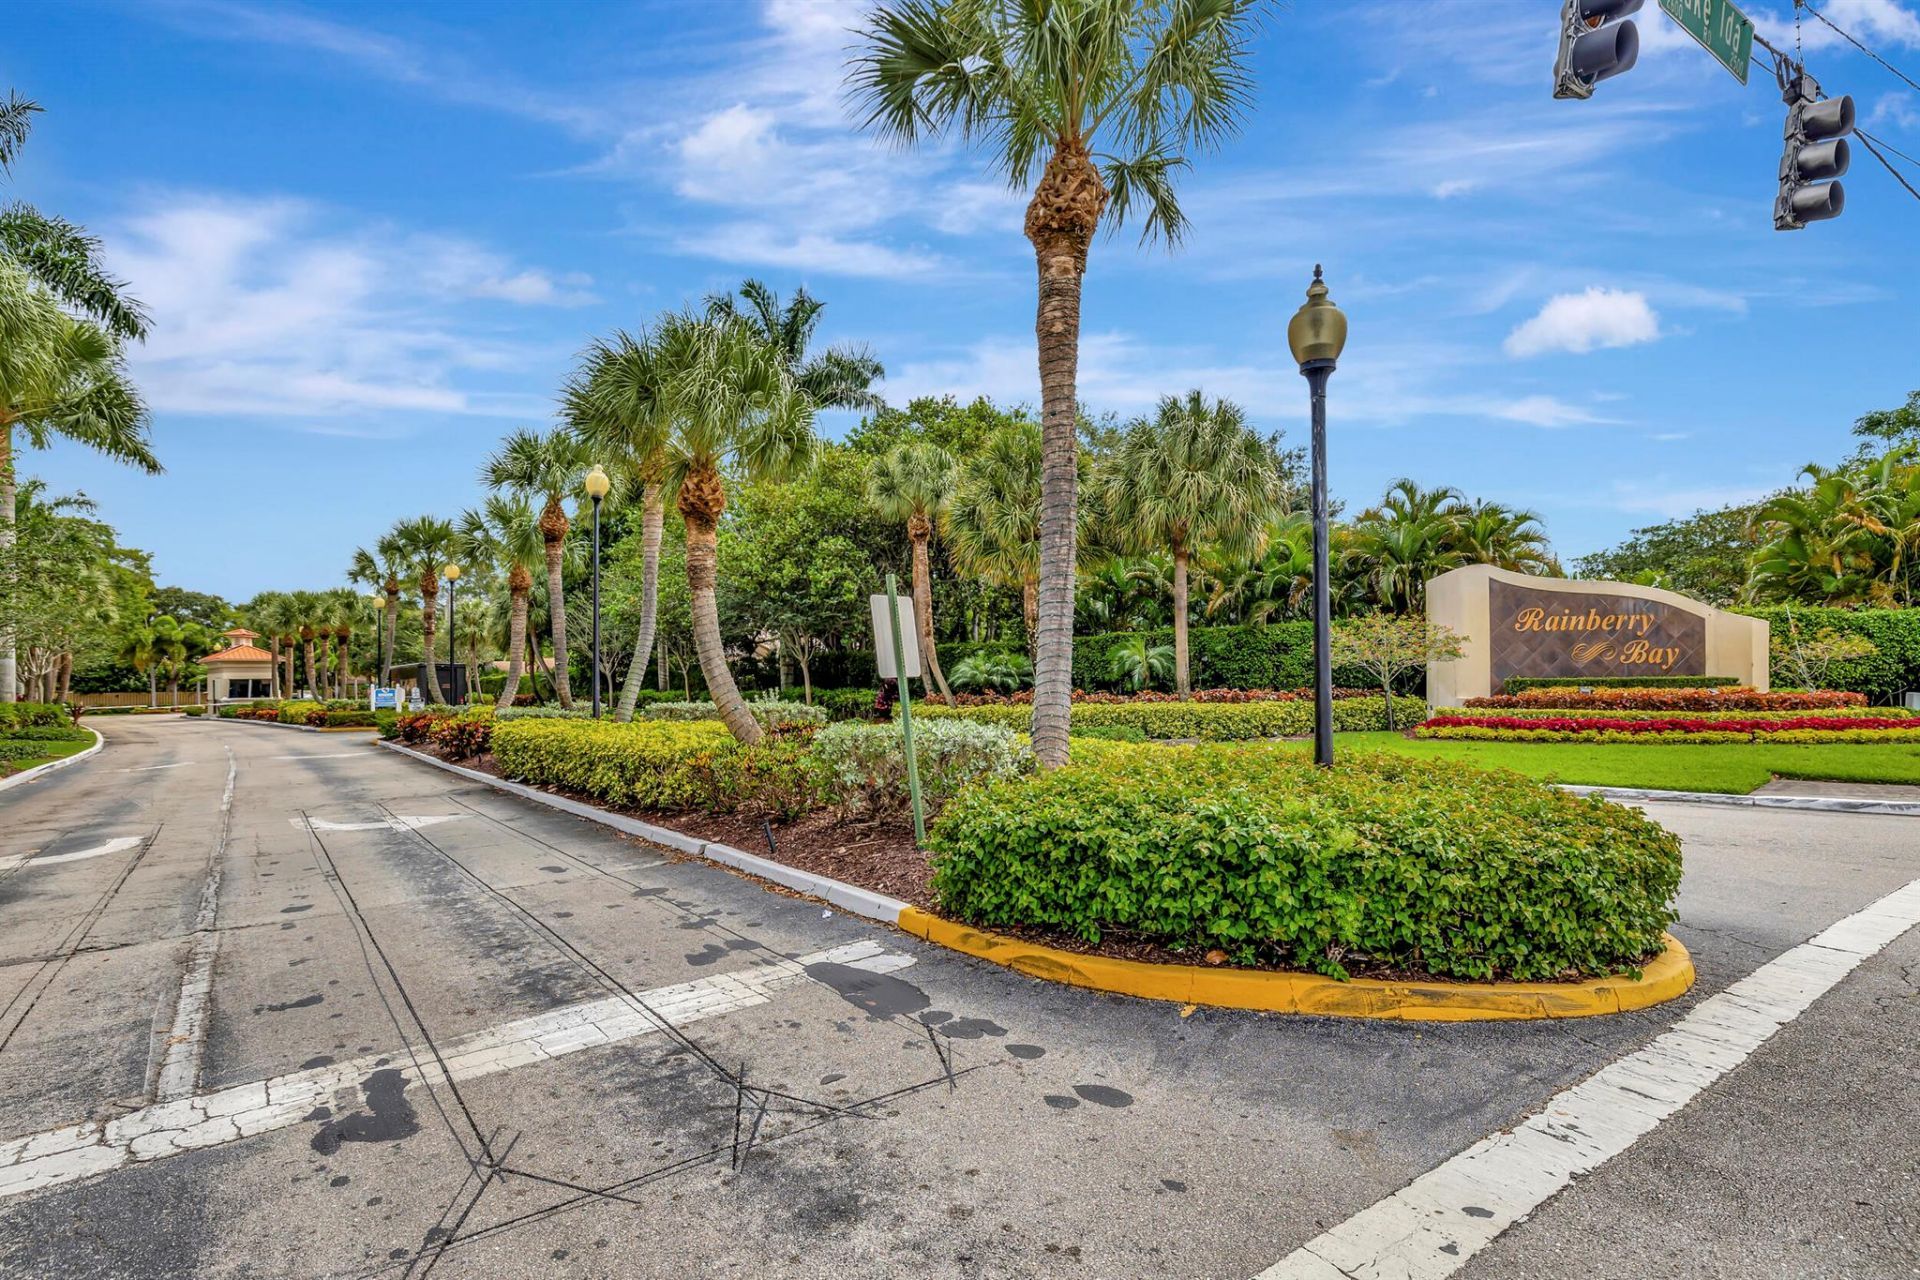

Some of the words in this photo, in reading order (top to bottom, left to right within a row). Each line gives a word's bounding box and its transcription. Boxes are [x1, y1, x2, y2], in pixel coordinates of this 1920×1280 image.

[1719, 1, 1741, 54] Ida
[1514, 607, 1655, 636] Rainberry
[1619, 639, 1680, 670] Bay
